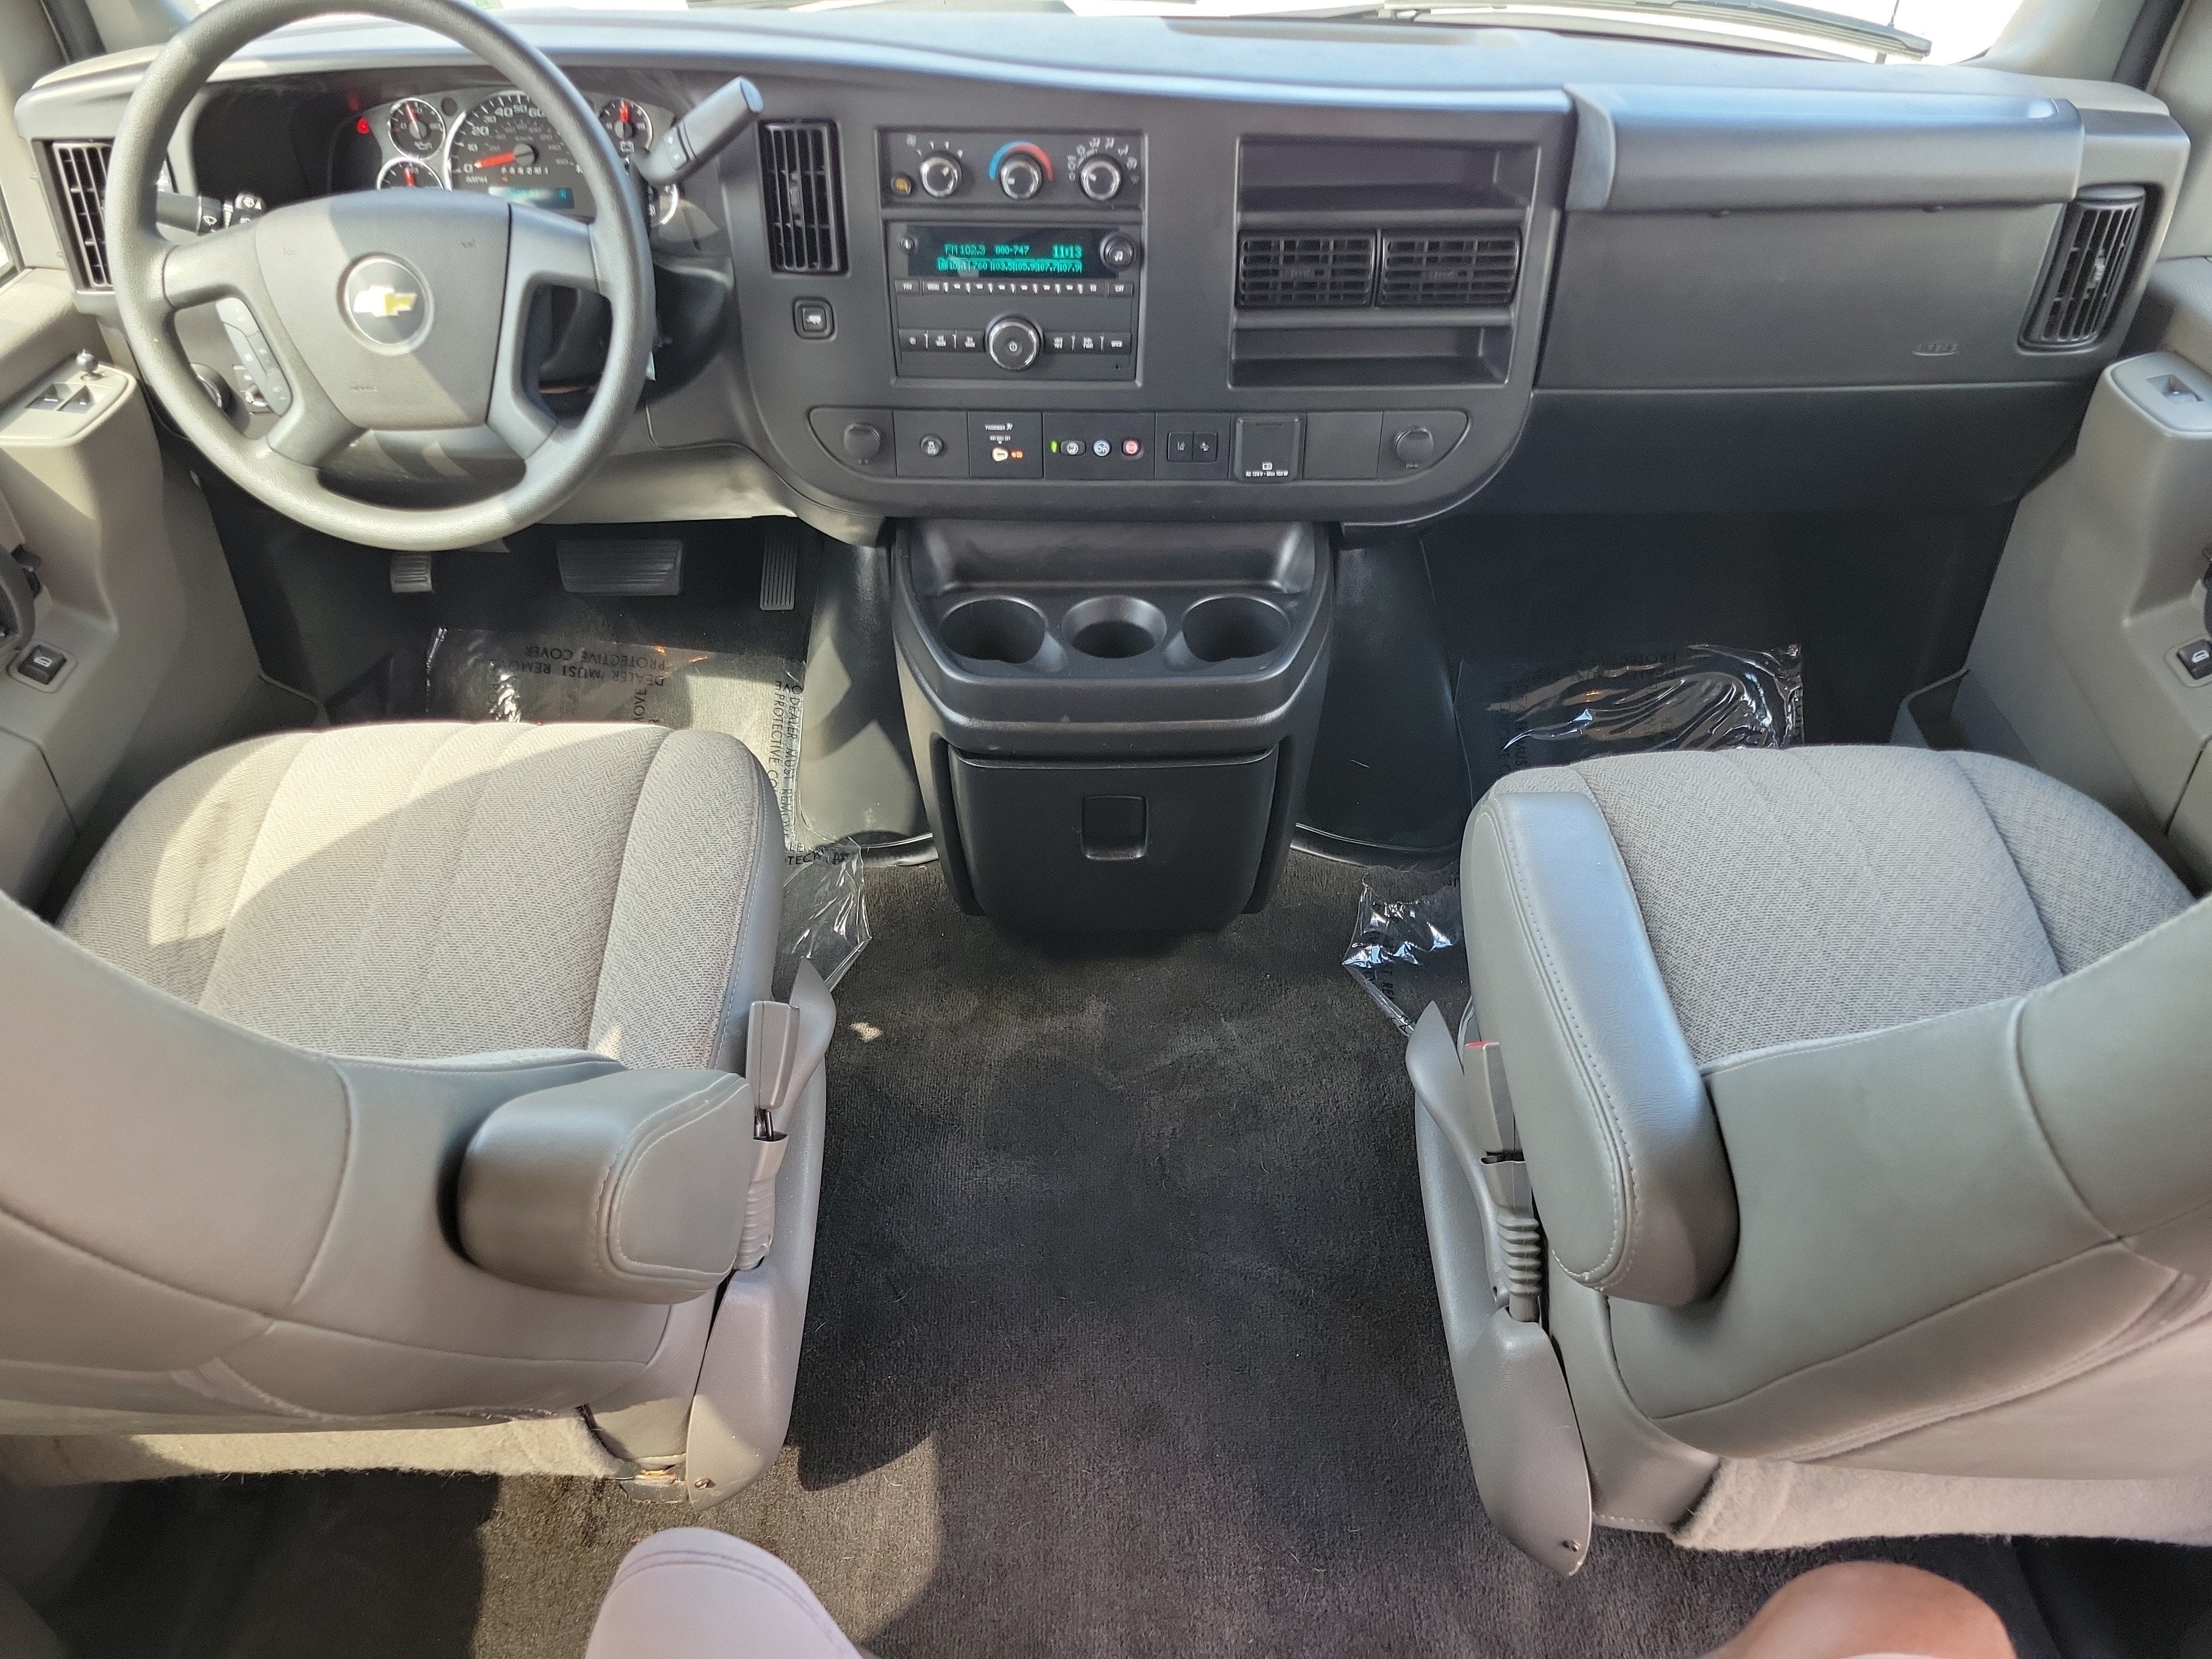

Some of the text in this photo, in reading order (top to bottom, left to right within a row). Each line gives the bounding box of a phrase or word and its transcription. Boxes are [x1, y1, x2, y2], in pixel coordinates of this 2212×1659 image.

[495, 107, 514, 117] 40
[471, 126, 489, 136] 20
[464, 163, 473, 173] 0
[1053, 245, 1081, 258] 11:13
[525, 645, 573, 660] COVER
[581, 651, 665, 670] PROTECTIVE
[613, 670, 664, 686] DEALER
[787, 697, 800, 740] DEALER
[768, 693, 785, 764] PROTECTIVE
[783, 747, 797, 782] MUST
